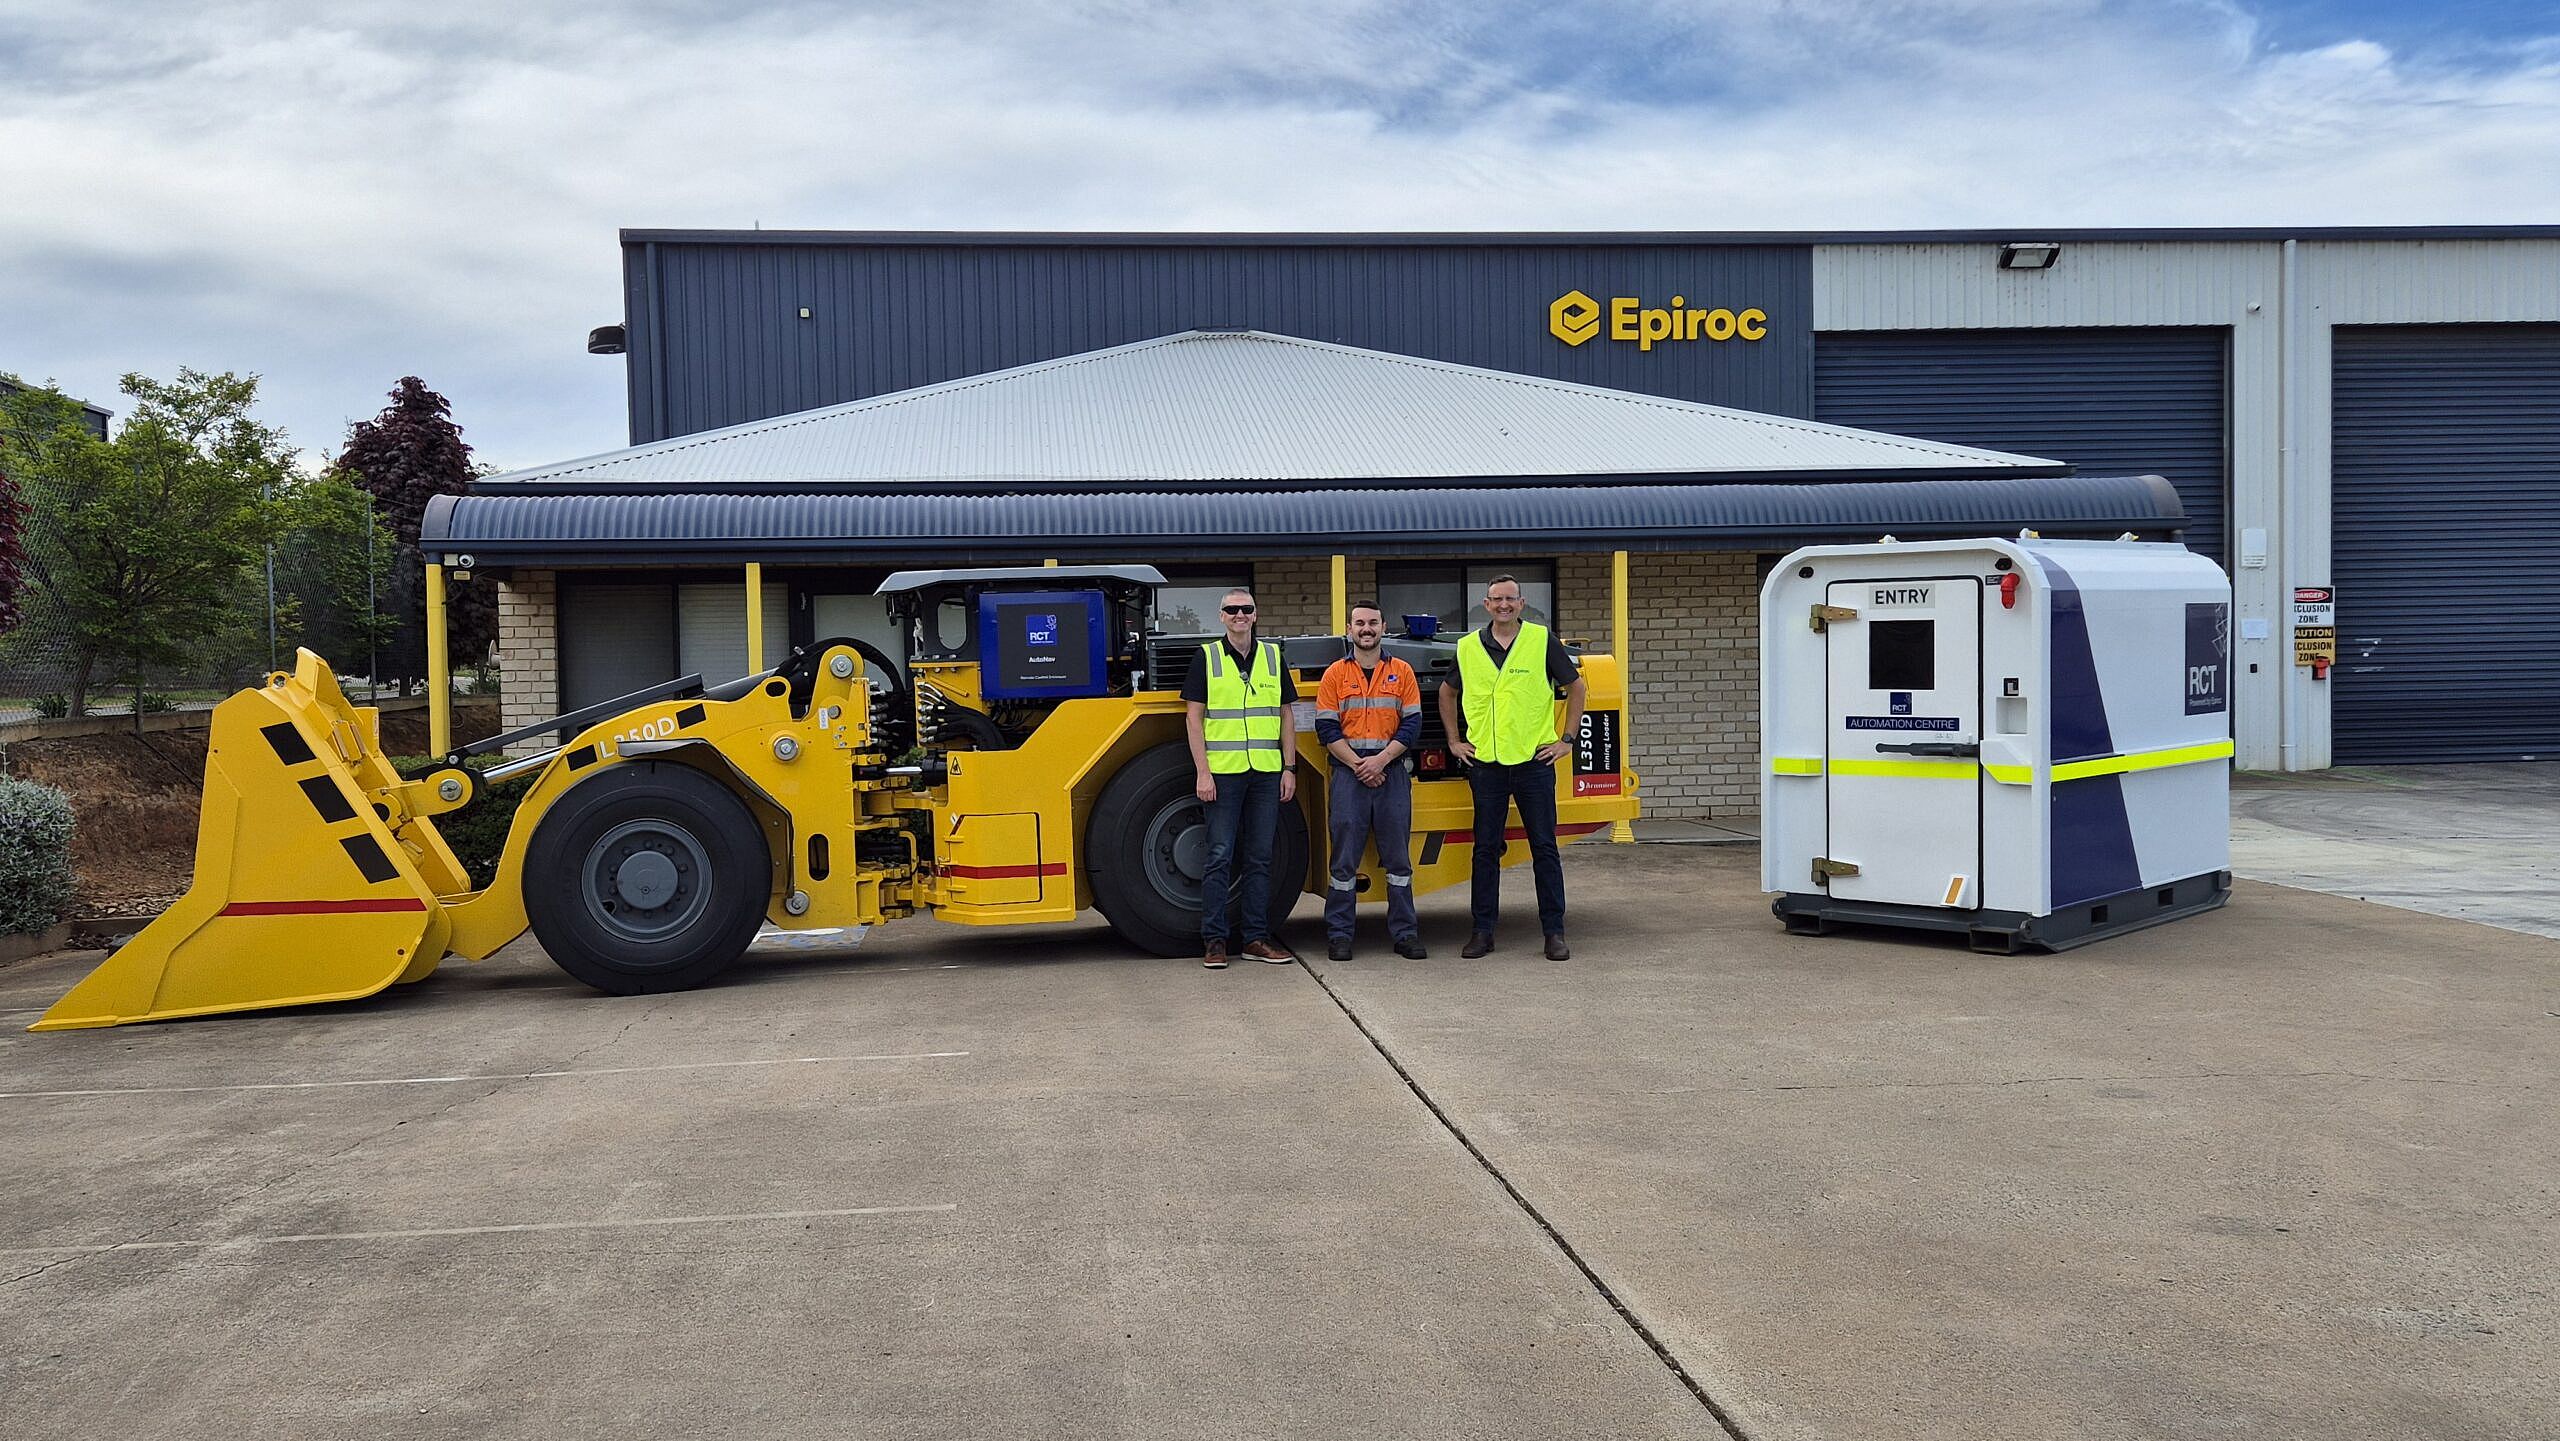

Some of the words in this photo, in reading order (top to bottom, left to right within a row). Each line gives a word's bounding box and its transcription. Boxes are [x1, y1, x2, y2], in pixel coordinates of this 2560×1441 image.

[1611, 295, 1768, 351] Epiroc
[1875, 588, 1929, 605] ENTRY
[2298, 615, 2319, 623] ZONE
[1030, 631, 1050, 641] RCT
[2295, 629, 2332, 637] AUTION
[2189, 665, 2217, 696] RCT
[1892, 704, 1907, 712] RCT
[1850, 718, 1912, 729] AUTOMATION
[1914, 719, 1955, 730] CENTRE
[1580, 714, 1593, 771] L350D
[1604, 743, 1612, 771] mining
